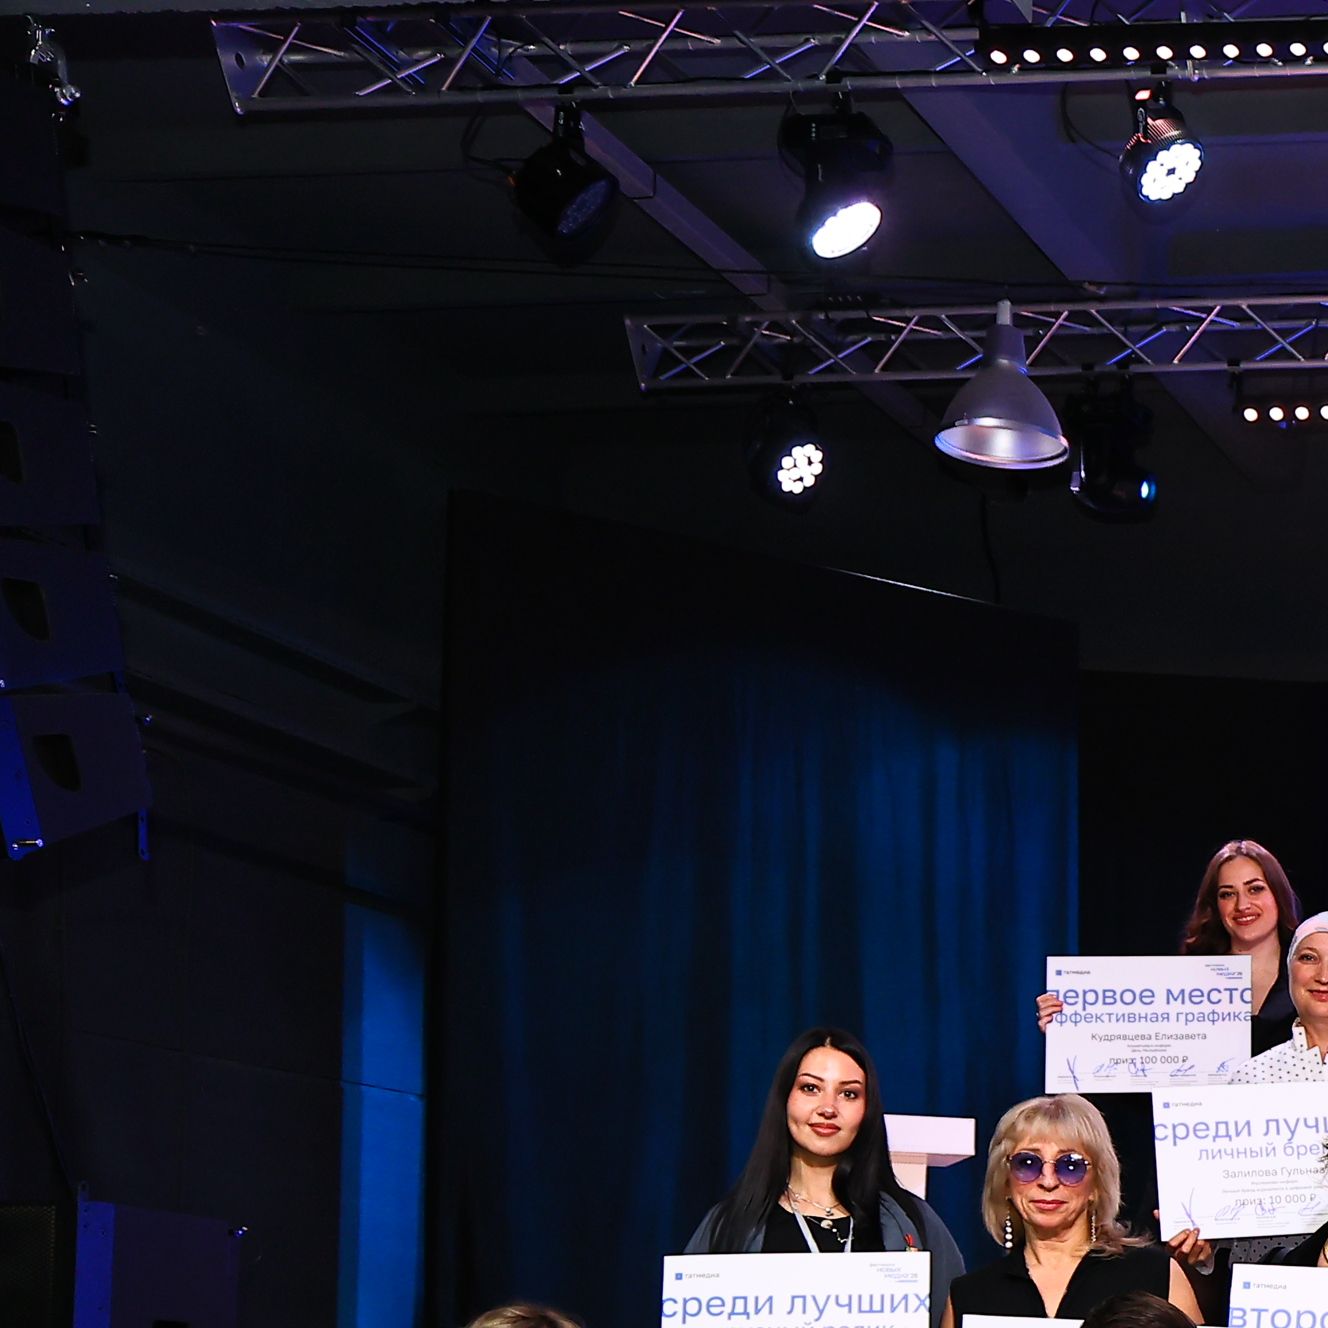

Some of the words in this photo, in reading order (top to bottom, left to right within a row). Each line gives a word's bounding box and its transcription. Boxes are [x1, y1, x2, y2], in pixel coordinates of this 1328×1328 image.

[1167, 987, 1252, 1006] место
[1055, 1010, 1170, 1026] ффективная
[1176, 1009, 1252, 1025] графика
[1091, 1033, 1152, 1042] Кудрявцева
[1155, 1032, 1206, 1041] Елизавета
[1140, 1056, 1155, 1064] 100
[1159, 1056, 1179, 1064] 000
[1154, 1119, 1251, 1146] среди
[1198, 1143, 1276, 1161] личный
[1284, 1141, 1323, 1159] бре
[1223, 1169, 1277, 1178] Залилова
[1269, 1196, 1281, 1204] 10
[1285, 1194, 1305, 1203] 000
[662, 1296, 774, 1324] среди
[787, 1293, 930, 1322] лучших
